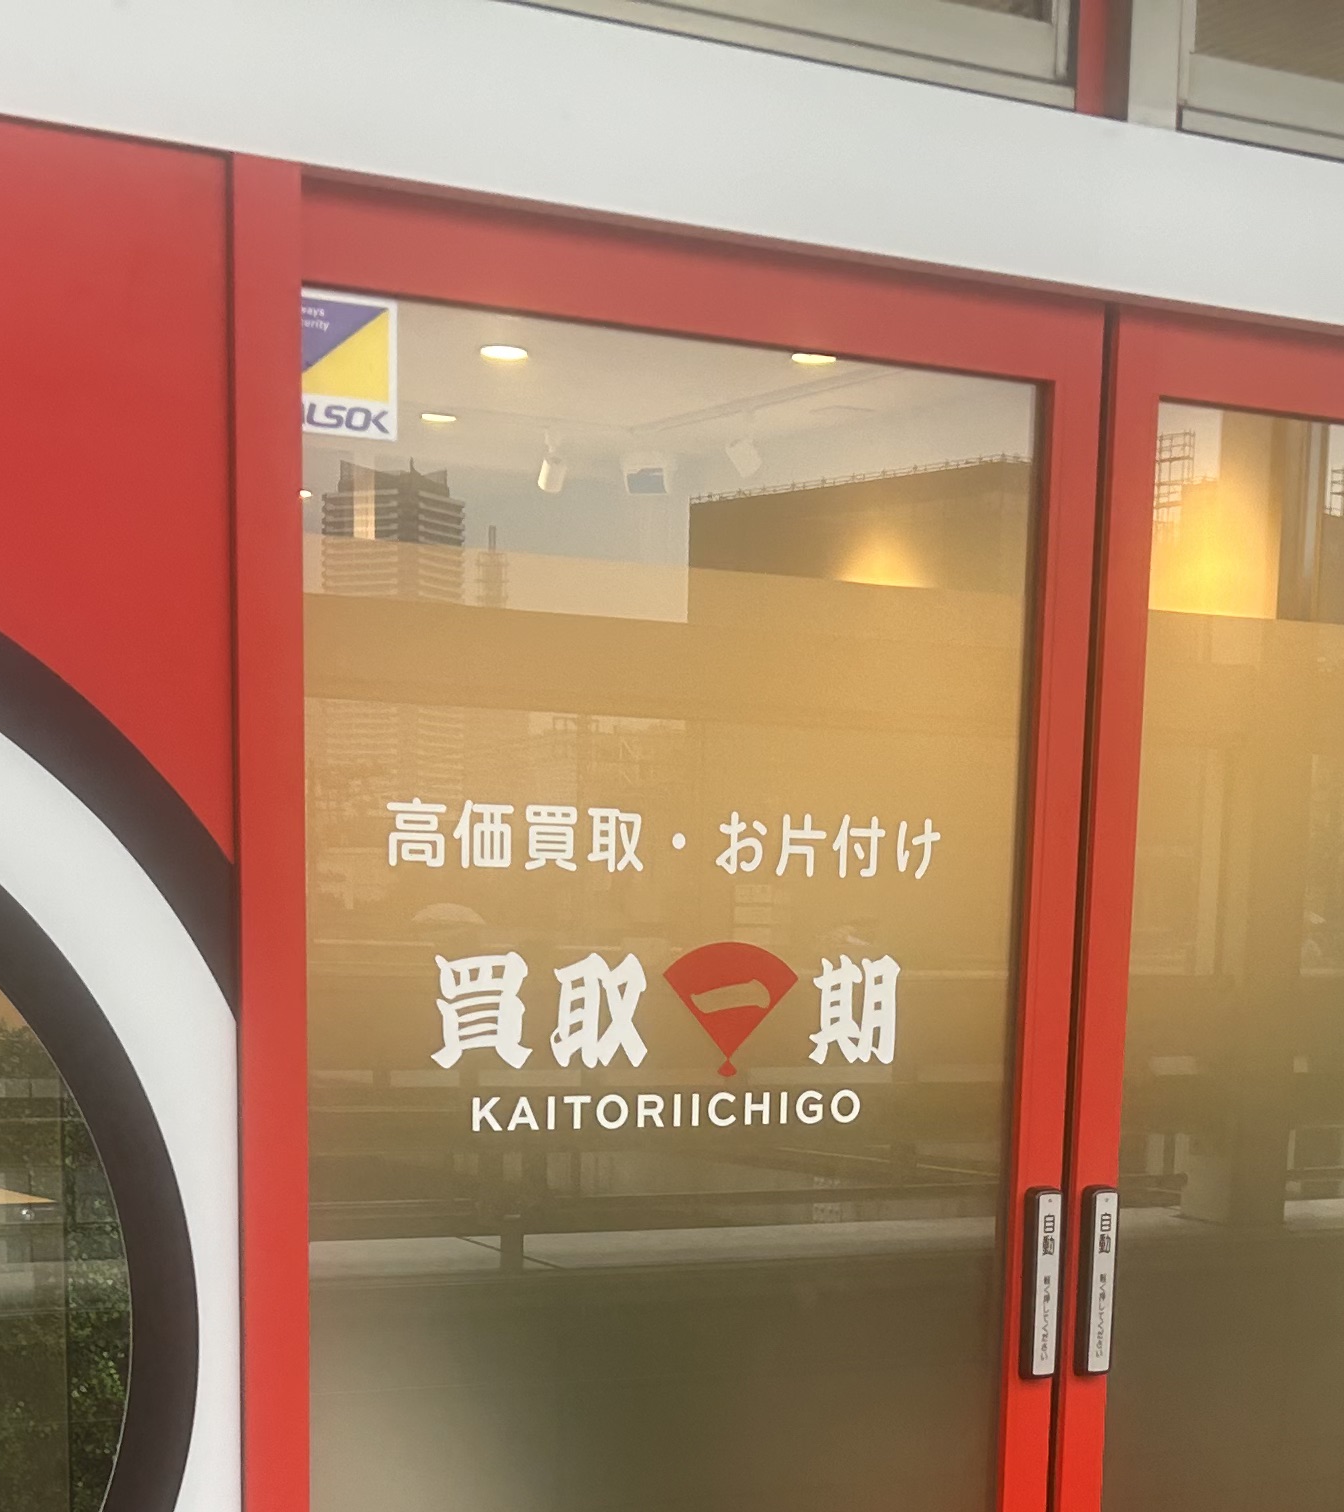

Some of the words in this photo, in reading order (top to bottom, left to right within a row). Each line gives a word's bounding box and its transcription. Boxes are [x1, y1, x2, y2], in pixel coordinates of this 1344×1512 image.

[303, 402, 389, 434] LSOK
[387, 798, 941, 879] 高価買取・お片付け
[430, 950, 901, 1068] 買取一期
[471, 1088, 862, 1132] KAITORIICHIGO
[1042, 1213, 1056, 1256] 自動
[1099, 1212, 1112, 1254] 自動
